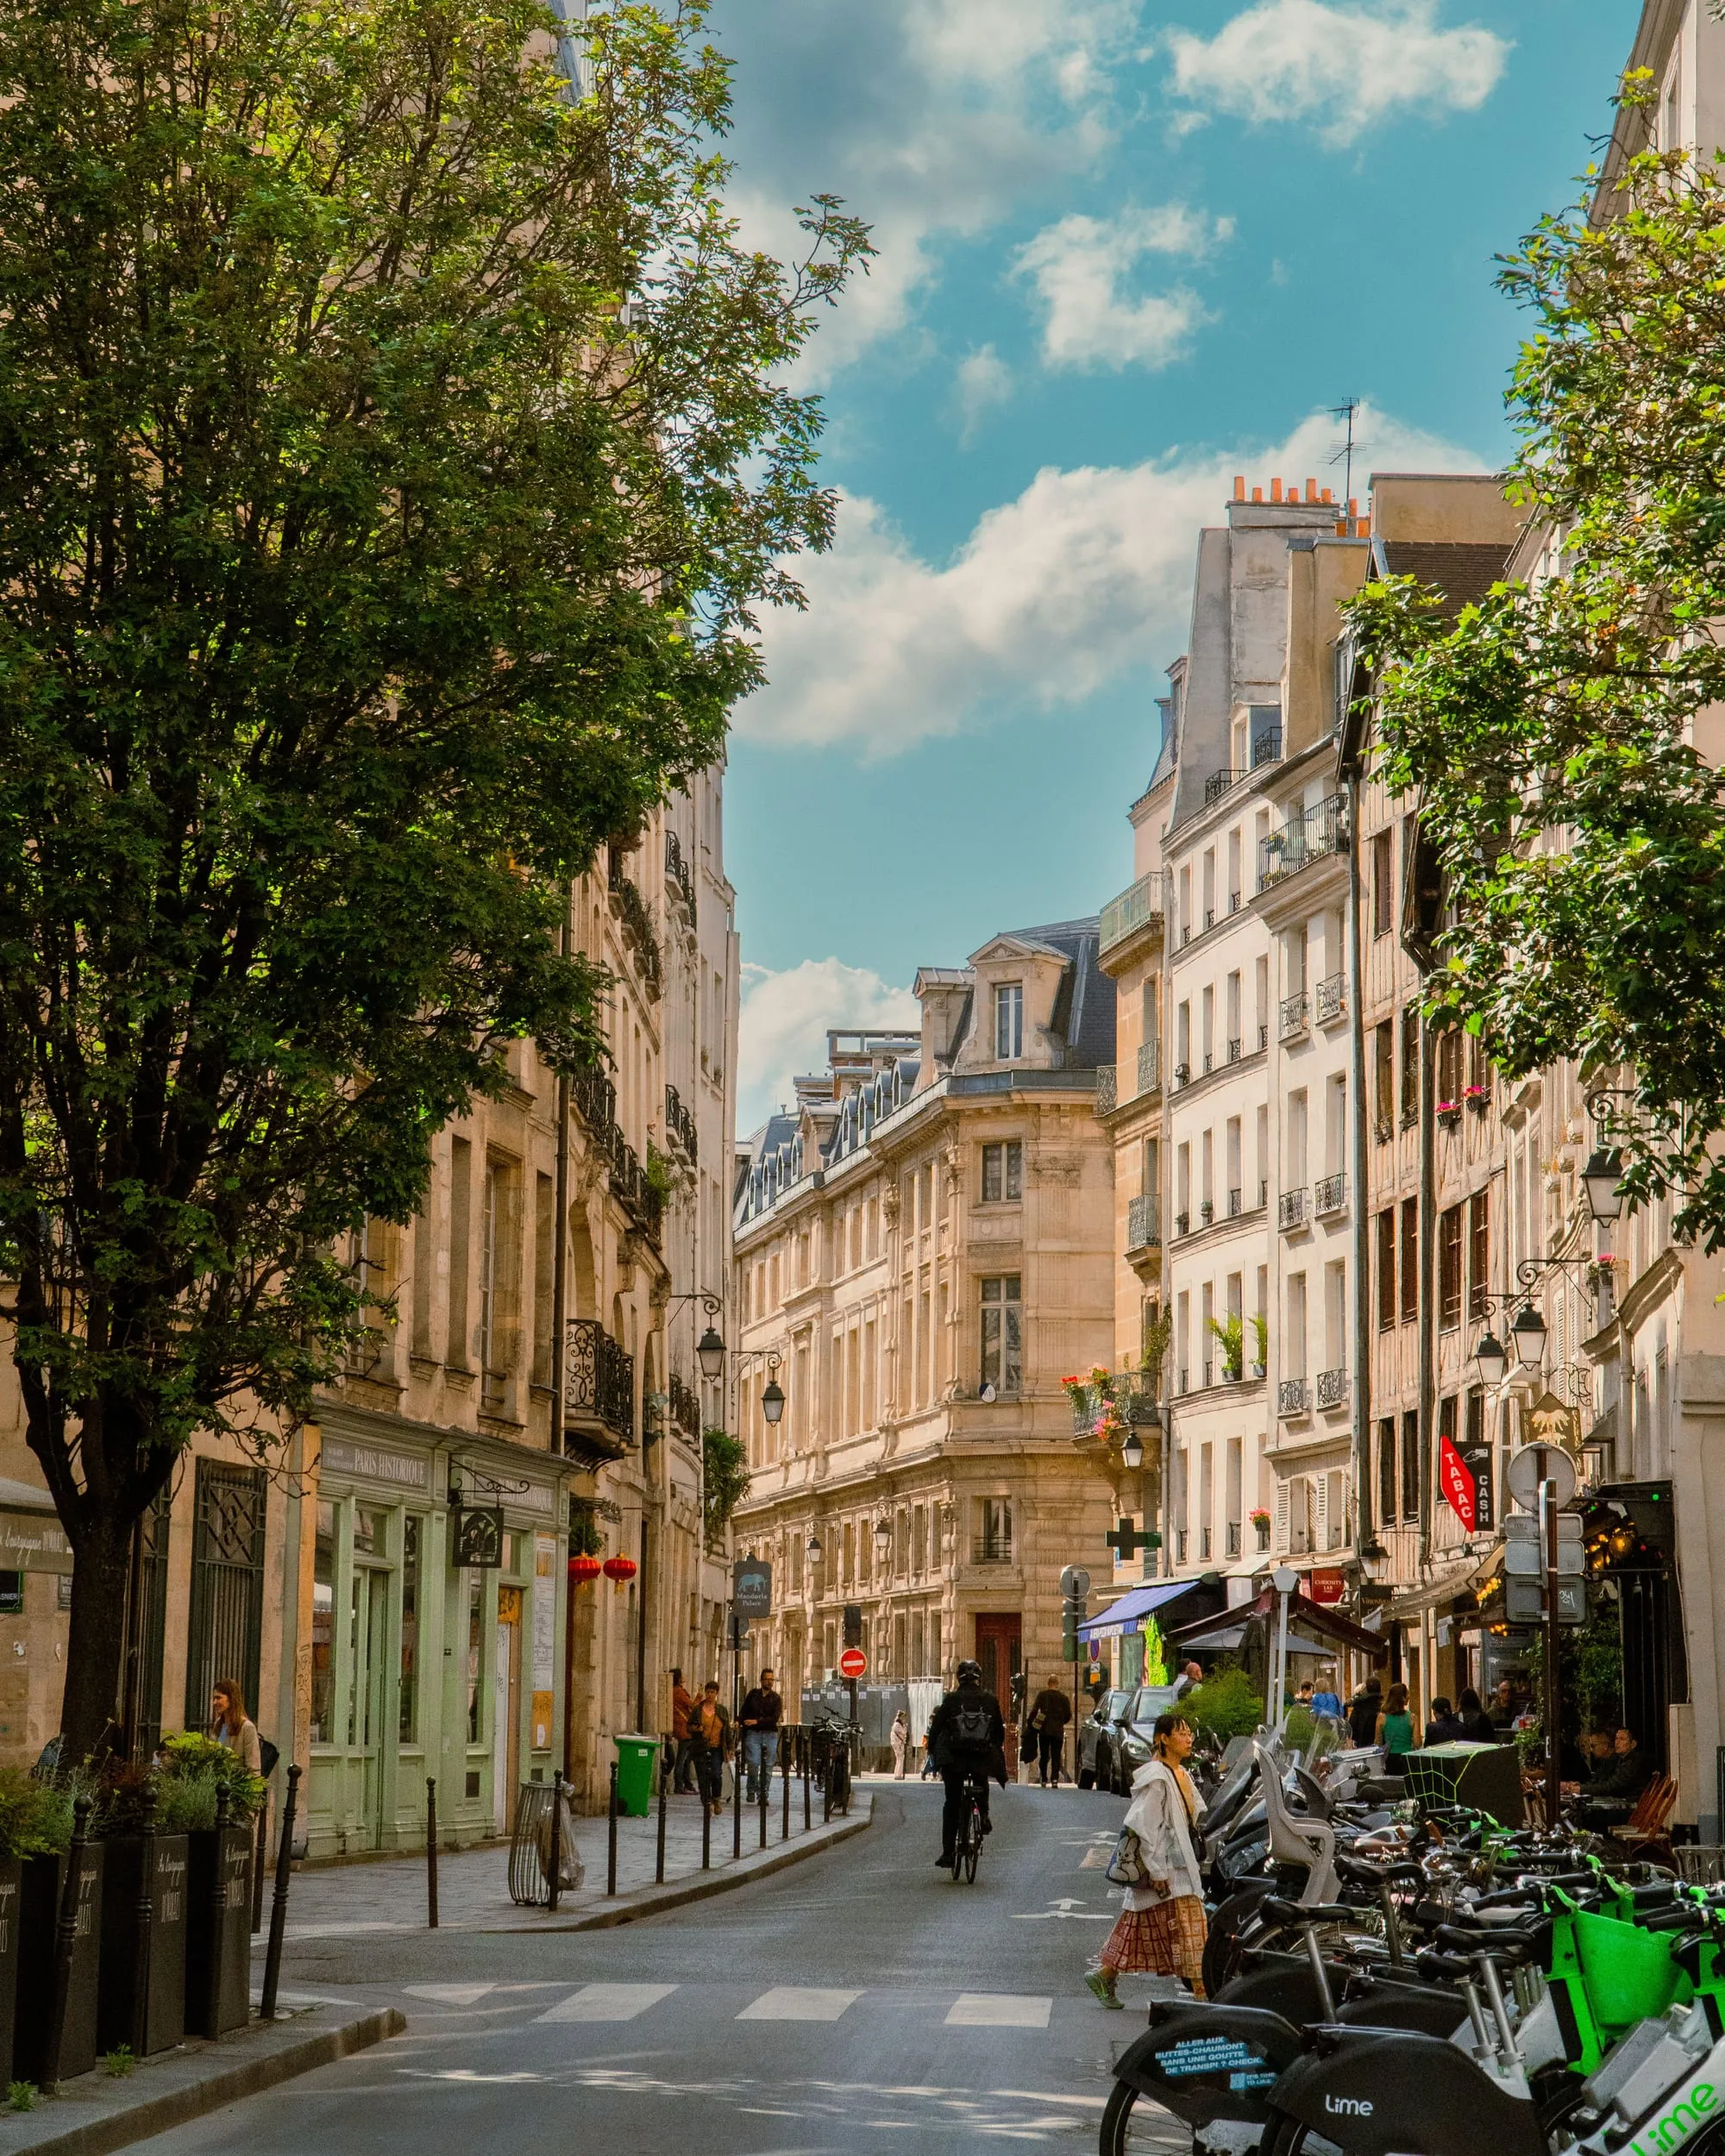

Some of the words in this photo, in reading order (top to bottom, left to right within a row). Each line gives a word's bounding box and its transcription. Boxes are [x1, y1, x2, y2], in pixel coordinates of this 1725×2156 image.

[354, 1449, 377, 1475] PARIS
[380, 1453, 424, 1484] HISTORIQUE
[1445, 1452, 1472, 1518] TABAC
[1479, 1475, 1489, 1522] CASH
[1155, 2043, 1245, 2059] BUTTES-CHAUMONT
[1175, 2039, 1204, 2049] ALLER
[1160, 2058, 1185, 2067] SANS
[1208, 2051, 1244, 2061] GOUTTE
[1179, 2063, 1219, 2072] TRANSPI
[1326, 2094, 1374, 2116] Lime
